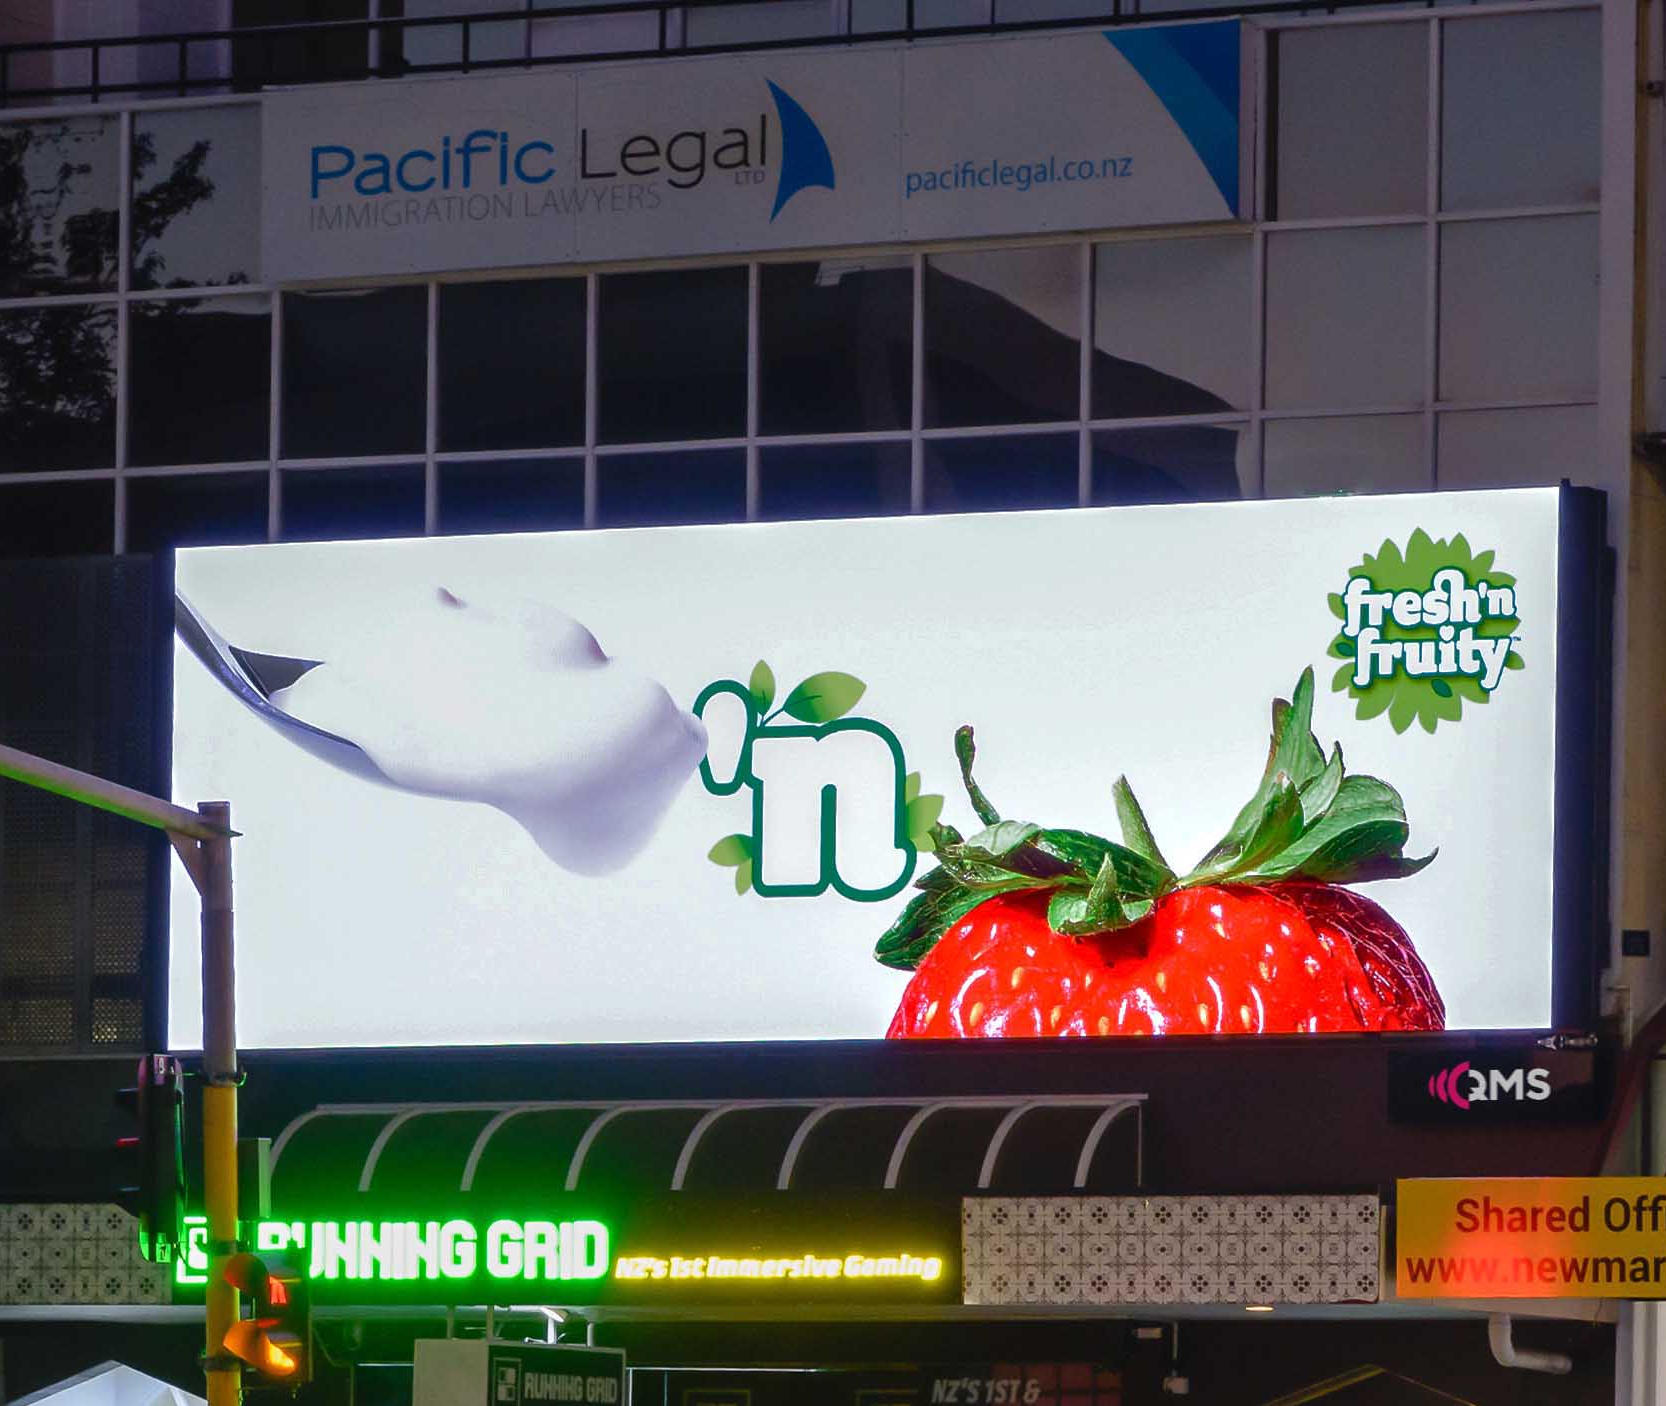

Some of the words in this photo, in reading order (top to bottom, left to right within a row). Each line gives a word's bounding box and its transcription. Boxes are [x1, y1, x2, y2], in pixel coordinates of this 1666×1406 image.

[309, 129, 556, 199] Pacific
[580, 113, 769, 191] Legal
[734, 166, 768, 186] LTD
[905, 153, 1133, 198] pacificlegal.co.nz
[309, 192, 513, 232] IMMIGRATION
[525, 181, 663, 217] LAWYERS
[1343, 567, 1518, 638] fresh'n
[1352, 625, 1512, 692] fruity
[1457, 1067, 1551, 1104] QMS
[1455, 1196, 1591, 1236] Shared
[486, 1219, 610, 1280] GRID
[843, 1254, 943, 1281] Gaming
[586, 1375, 618, 1404] GRID
[932, 1377, 984, 1404] NZ'S
[984, 1378, 1022, 1404] 1ST
[1022, 1379, 1042, 1404] &
